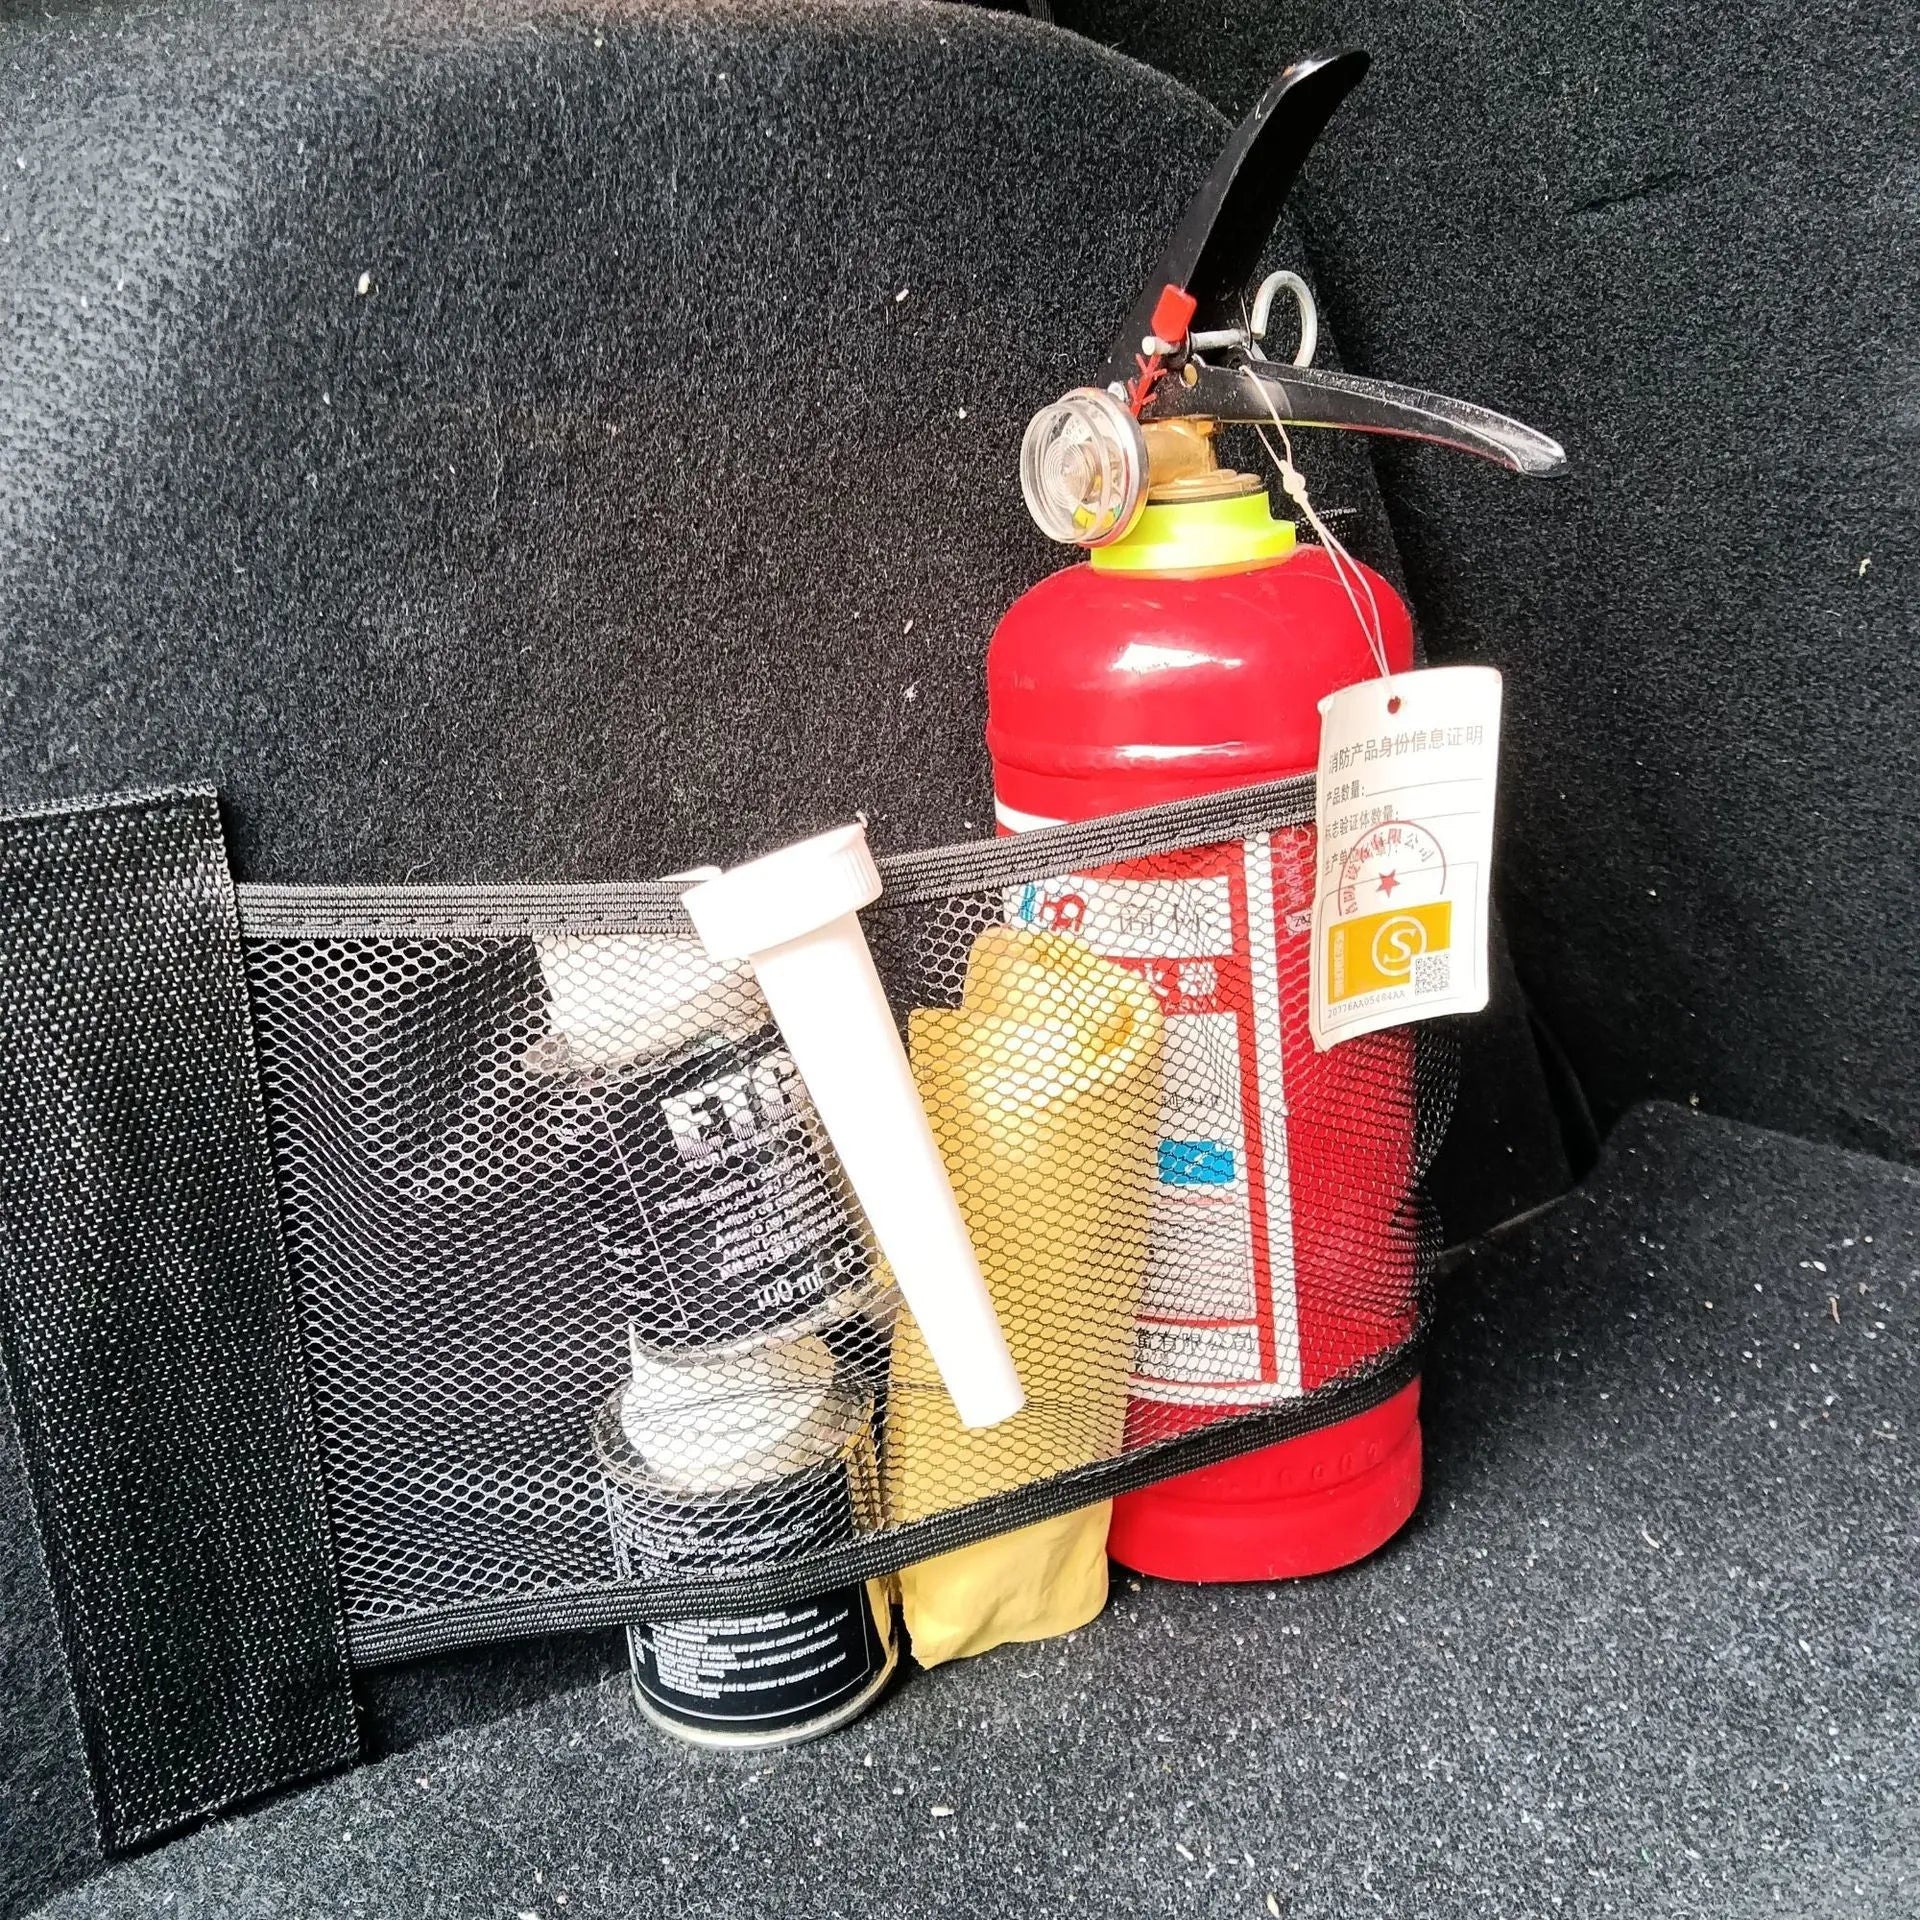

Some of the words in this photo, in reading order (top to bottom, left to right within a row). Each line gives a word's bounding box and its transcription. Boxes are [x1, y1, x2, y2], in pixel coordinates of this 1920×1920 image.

[1328, 724, 1484, 775] 消防产品身份信息证明
[761, 1652, 791, 1667] POISON
